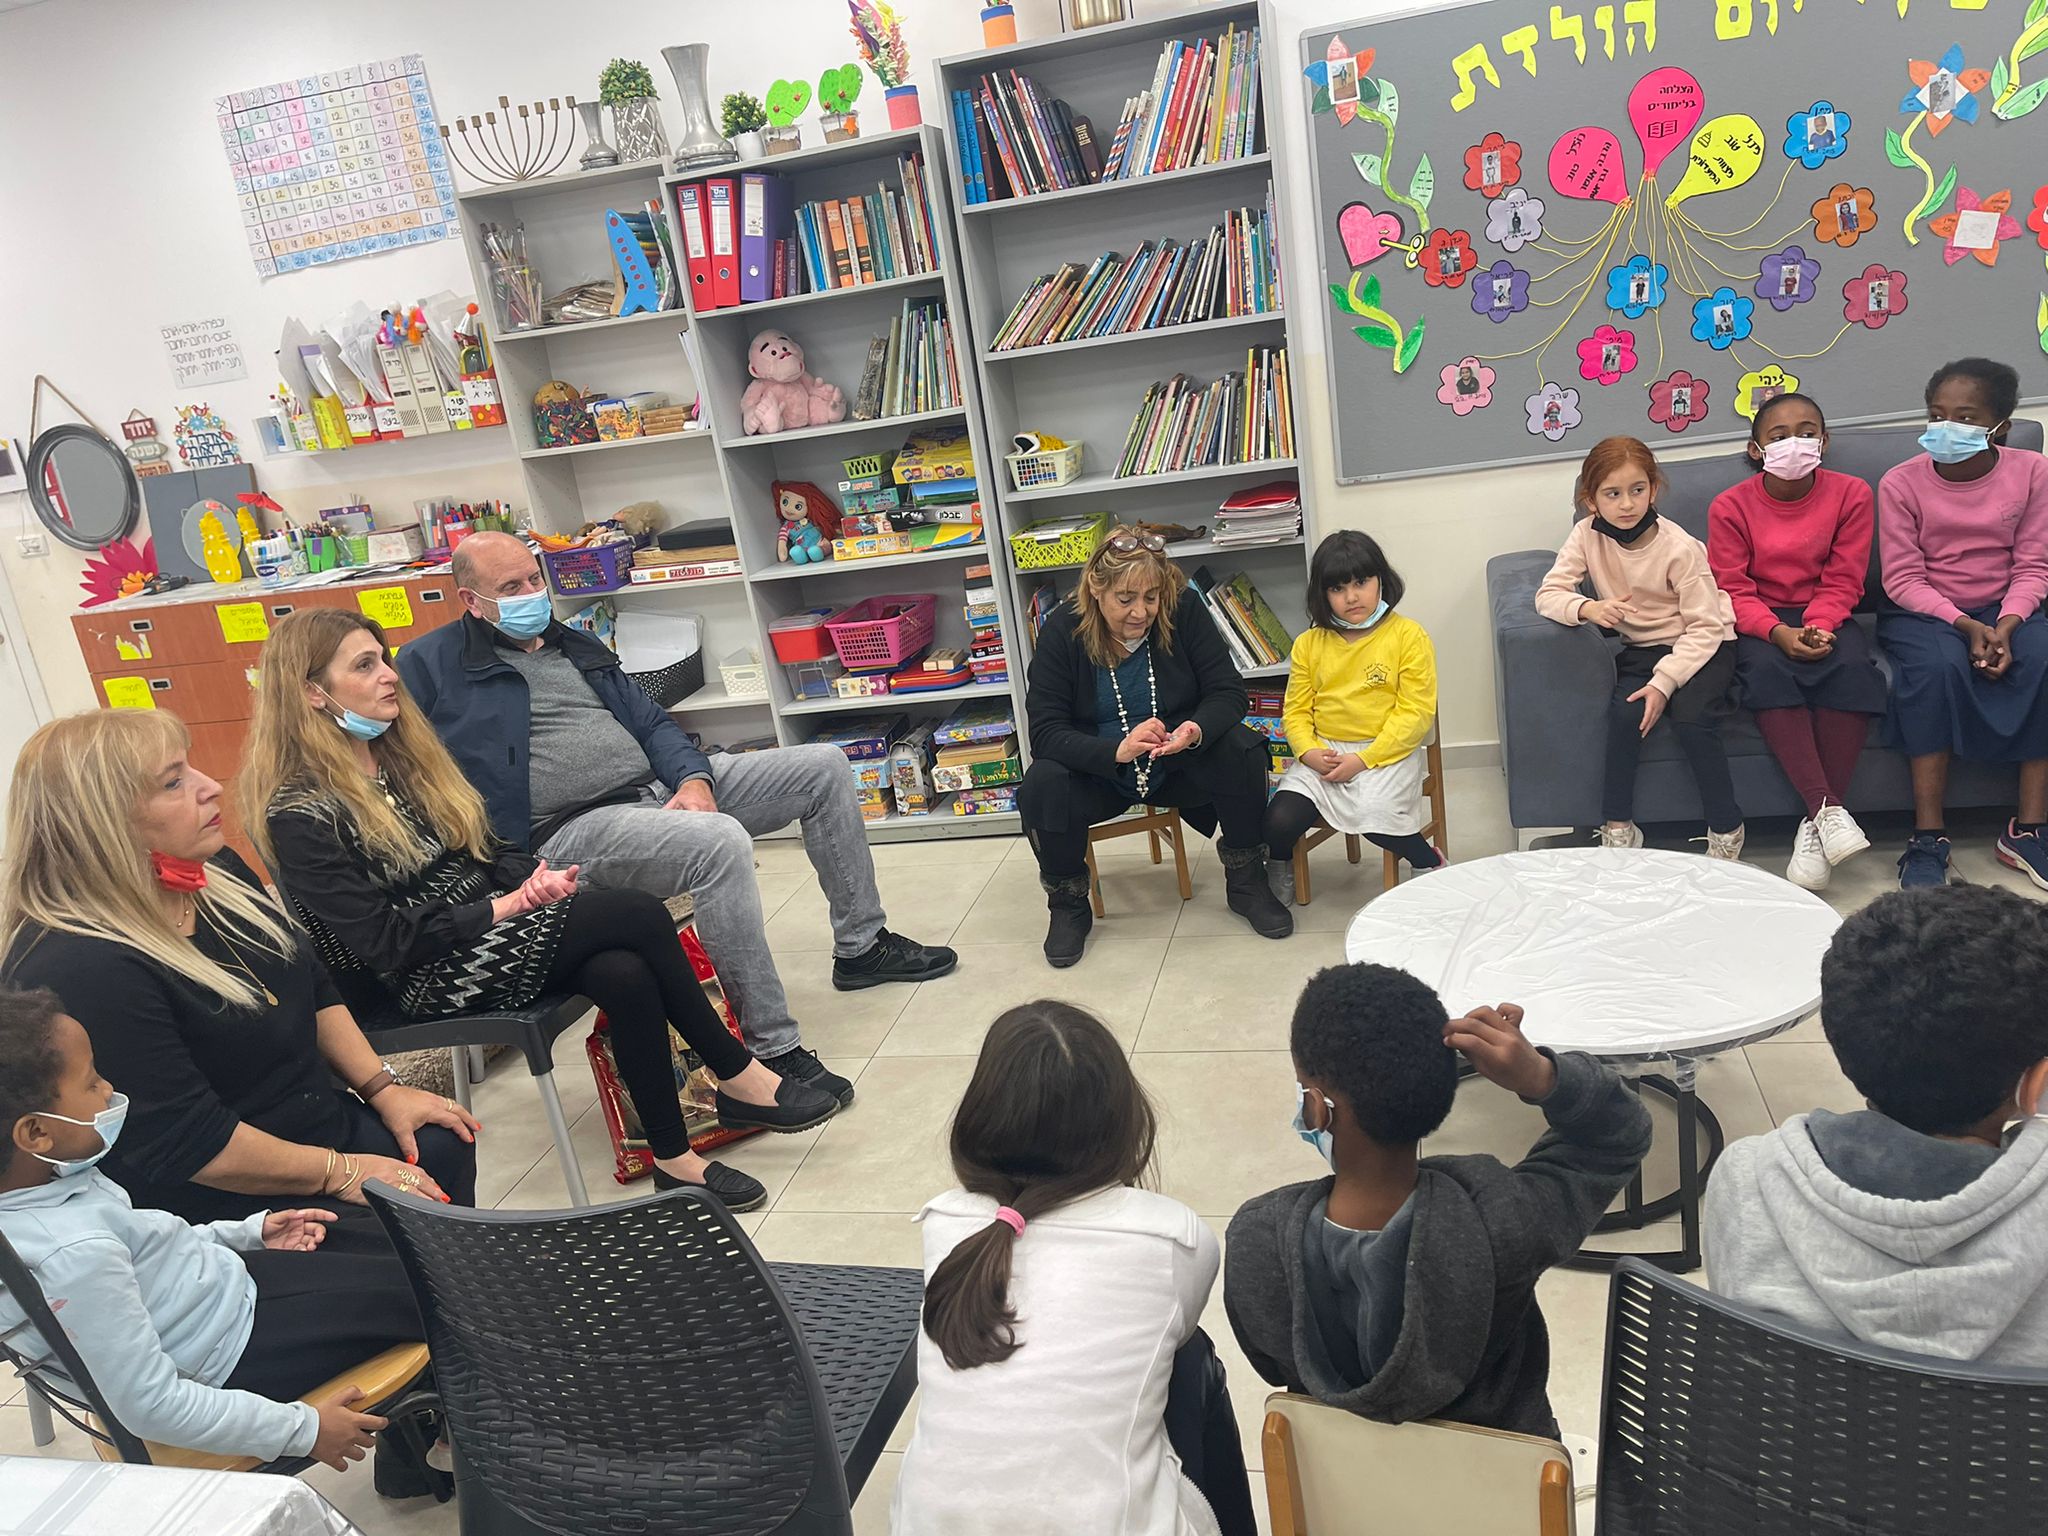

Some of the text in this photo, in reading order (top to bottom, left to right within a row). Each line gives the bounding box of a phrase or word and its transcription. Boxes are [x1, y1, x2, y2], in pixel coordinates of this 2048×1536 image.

[1450, 0, 1803, 112] ום הולדת
[234, 97, 241, 108] 1
[269, 87, 277, 99] 3
[306, 80, 313, 91] 5
[322, 76, 330, 87] 6
[344, 71, 351, 83] 7
[367, 67, 374, 80] 8
[389, 64, 397, 76] 9
[1660, 85, 1693, 94] הצלחה
[240, 116, 245, 125] 1
[256, 111, 264, 119] 2
[275, 106, 281, 115] 3
[312, 99, 317, 107] 5
[328, 95, 334, 103] 6
[1648, 100, 1696, 111] בלימודים
[381, 136, 393, 145] 32
[233, 150, 240, 161] 3
[282, 140, 288, 148] 9
[241, 180, 248, 191] 5
[324, 164, 335, 174] 25
[344, 162, 355, 171] 30
[385, 153, 396, 161] 40
[352, 192, 363, 200] 42
[372, 187, 382, 196] 49
[415, 178, 425, 187] 63
[682, 190, 695, 199] Uni
[714, 186, 727, 195] Uni
[245, 197, 252, 207] 6
[254, 228, 261, 240] 8
[376, 203, 387, 212] 56
[258, 246, 266, 257] 9
[341, 229, 352, 237] 45
[126, 421, 151, 437] יחד
[131, 444, 160, 458] נשנה
